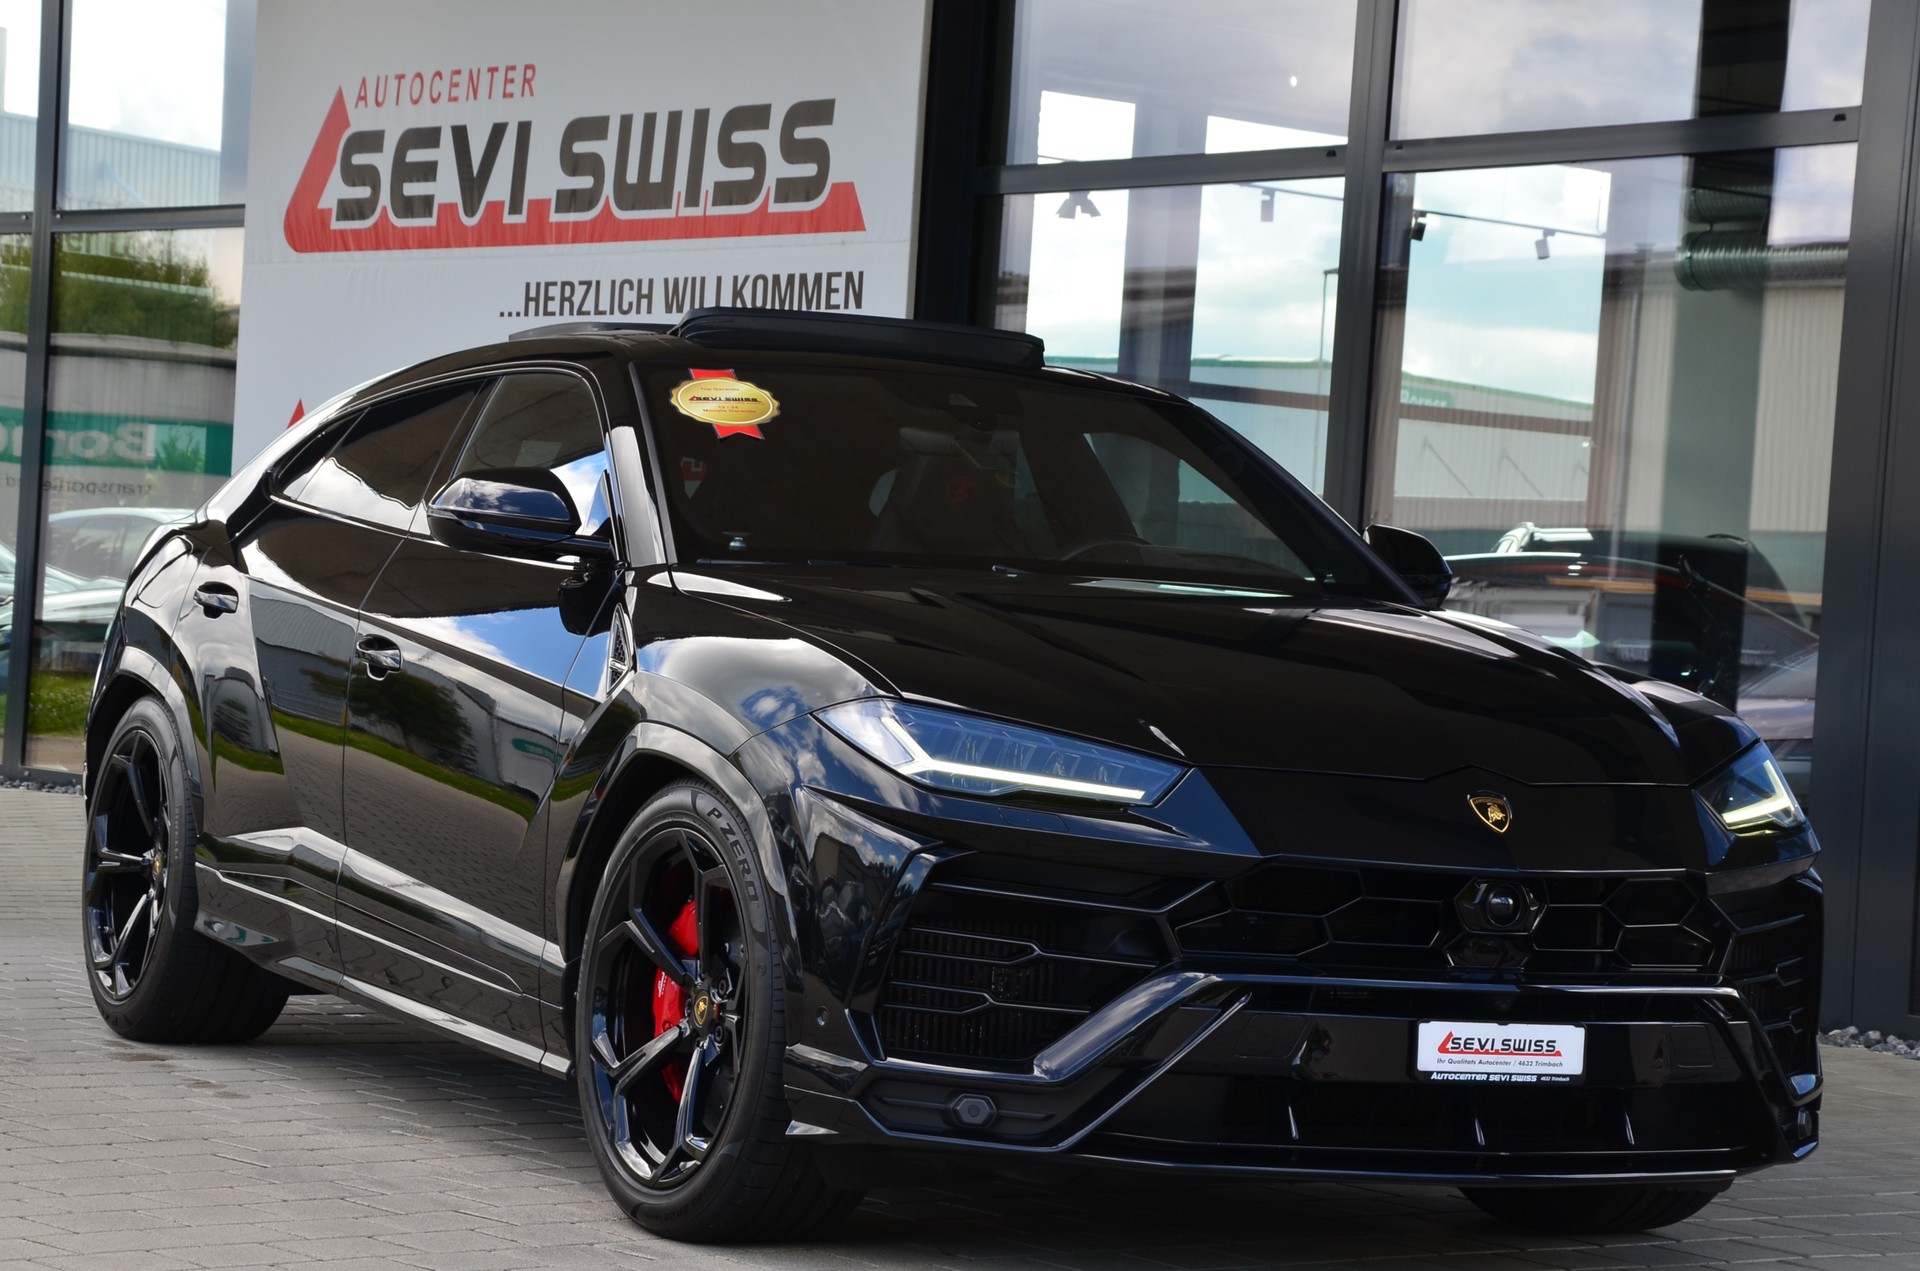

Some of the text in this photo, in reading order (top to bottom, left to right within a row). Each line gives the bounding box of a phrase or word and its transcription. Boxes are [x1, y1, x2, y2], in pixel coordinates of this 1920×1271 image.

[355, 63, 537, 109] AUTOCENTER
[335, 98, 836, 222] SEVI SWISS
[663, 270, 865, 314] WILLKOMMEN
[706, 807, 759, 902] P ZERO
[1450, 1037, 1557, 1053] SEVI SWISS
[1488, 1073, 1510, 1082] SEVI
[1511, 1074, 1538, 1082] SWISS
